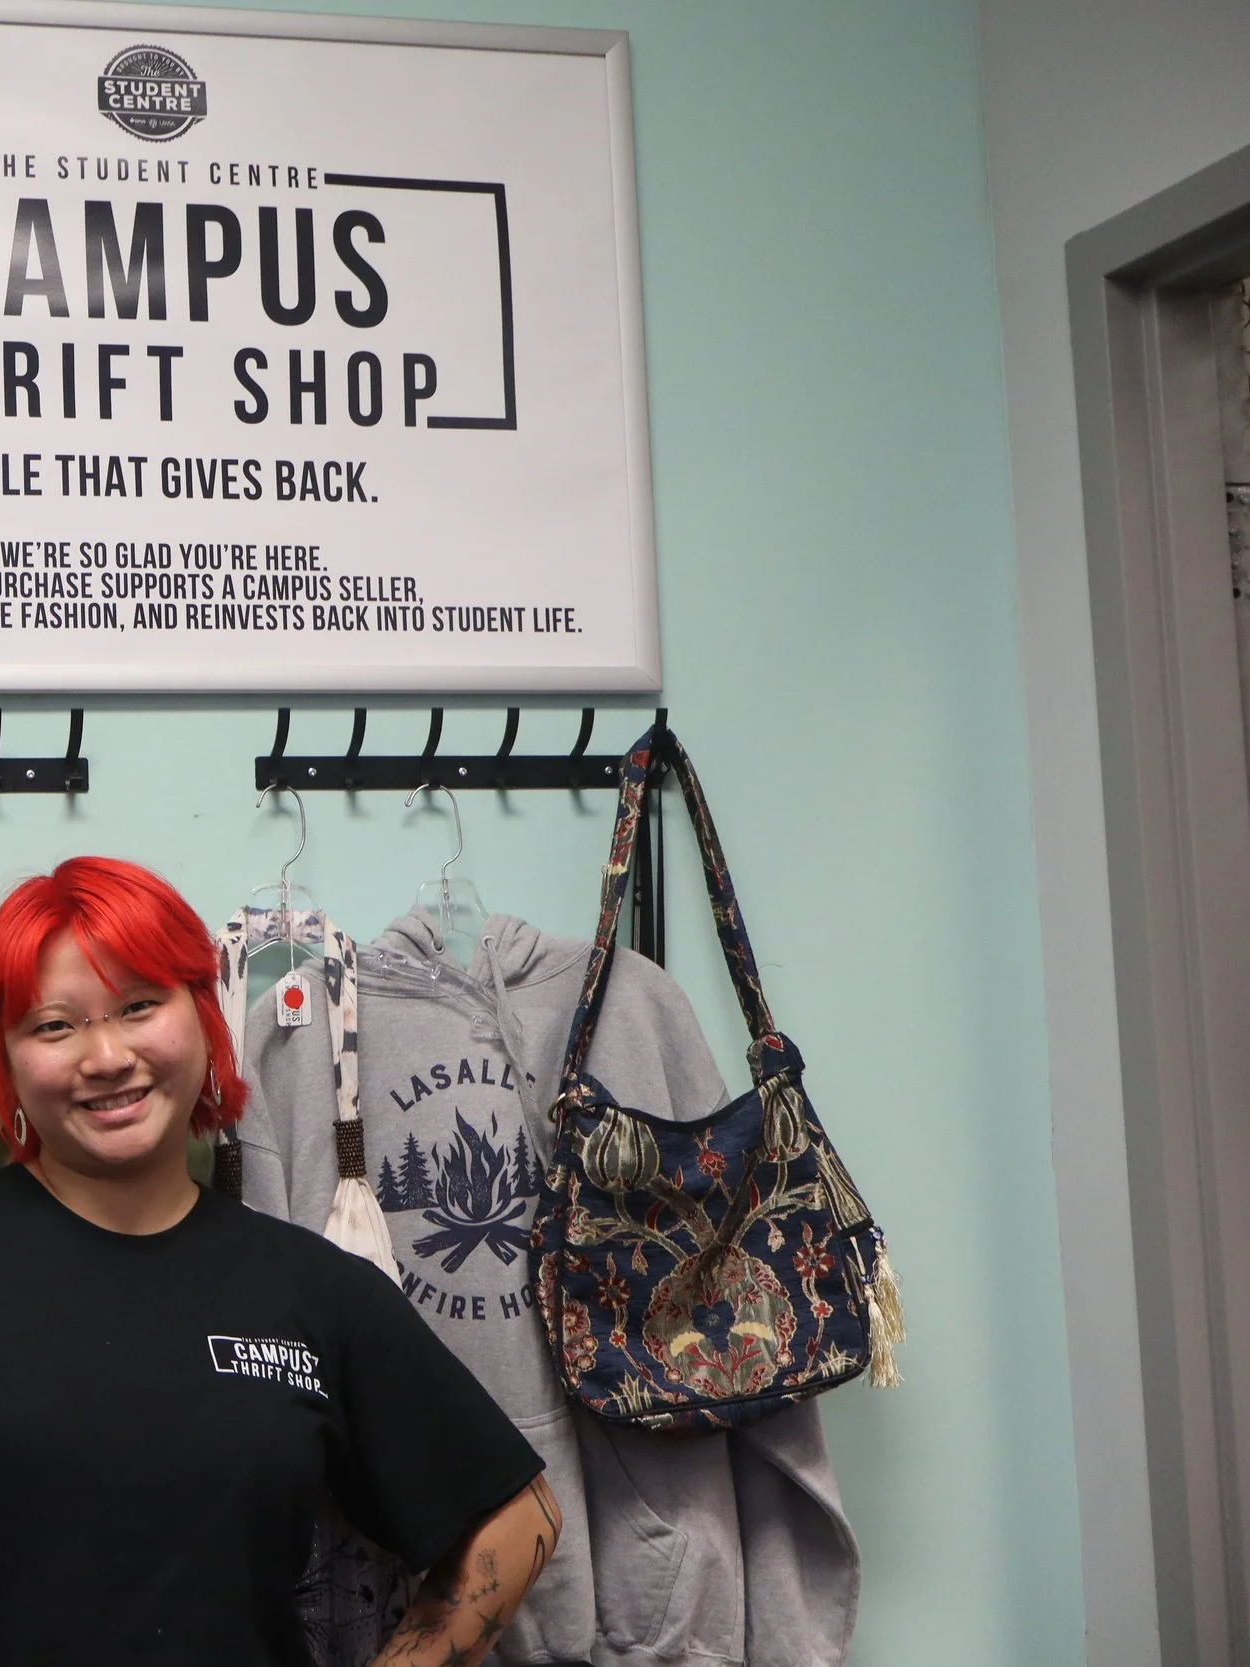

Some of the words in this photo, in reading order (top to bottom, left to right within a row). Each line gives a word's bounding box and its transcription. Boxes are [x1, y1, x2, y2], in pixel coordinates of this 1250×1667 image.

[140, 66, 161, 78] The
[104, 80, 202, 98] STUDENT
[108, 94, 192, 112] CENTRE
[57, 157, 190, 184] STUDENT
[209, 163, 319, 190] CENTRE
[233, 347, 438, 428] SHOP
[55, 454, 148, 498] THAT
[161, 457, 263, 500] GIVES
[275, 459, 379, 503] BACK.
[0, 541, 72, 569] WE'RE
[79, 542, 108, 569] SO
[115, 542, 172, 569] GLAD
[179, 543, 258, 571] YOU'RE
[265, 544, 328, 572] HERE.
[100, 573, 214, 600] SUPPORTS
[221, 574, 236, 600] A
[243, 575, 332, 602] CAMPUS
[339, 576, 424, 605] SELLER,
[20, 602, 125, 632] FASHION,
[133, 603, 178, 630] AND
[185, 604, 305, 631] REINVESTS
[312, 605, 369, 632] BACK
[376, 606, 425, 632] INTO
[432, 606, 526, 633] STUDENT
[533, 607, 583, 633] LIFE.
[234, 1342, 313, 1375] CAMPUS
[231, 1360, 283, 1382] THRIFT
[287, 1371, 321, 1393] SHOP
